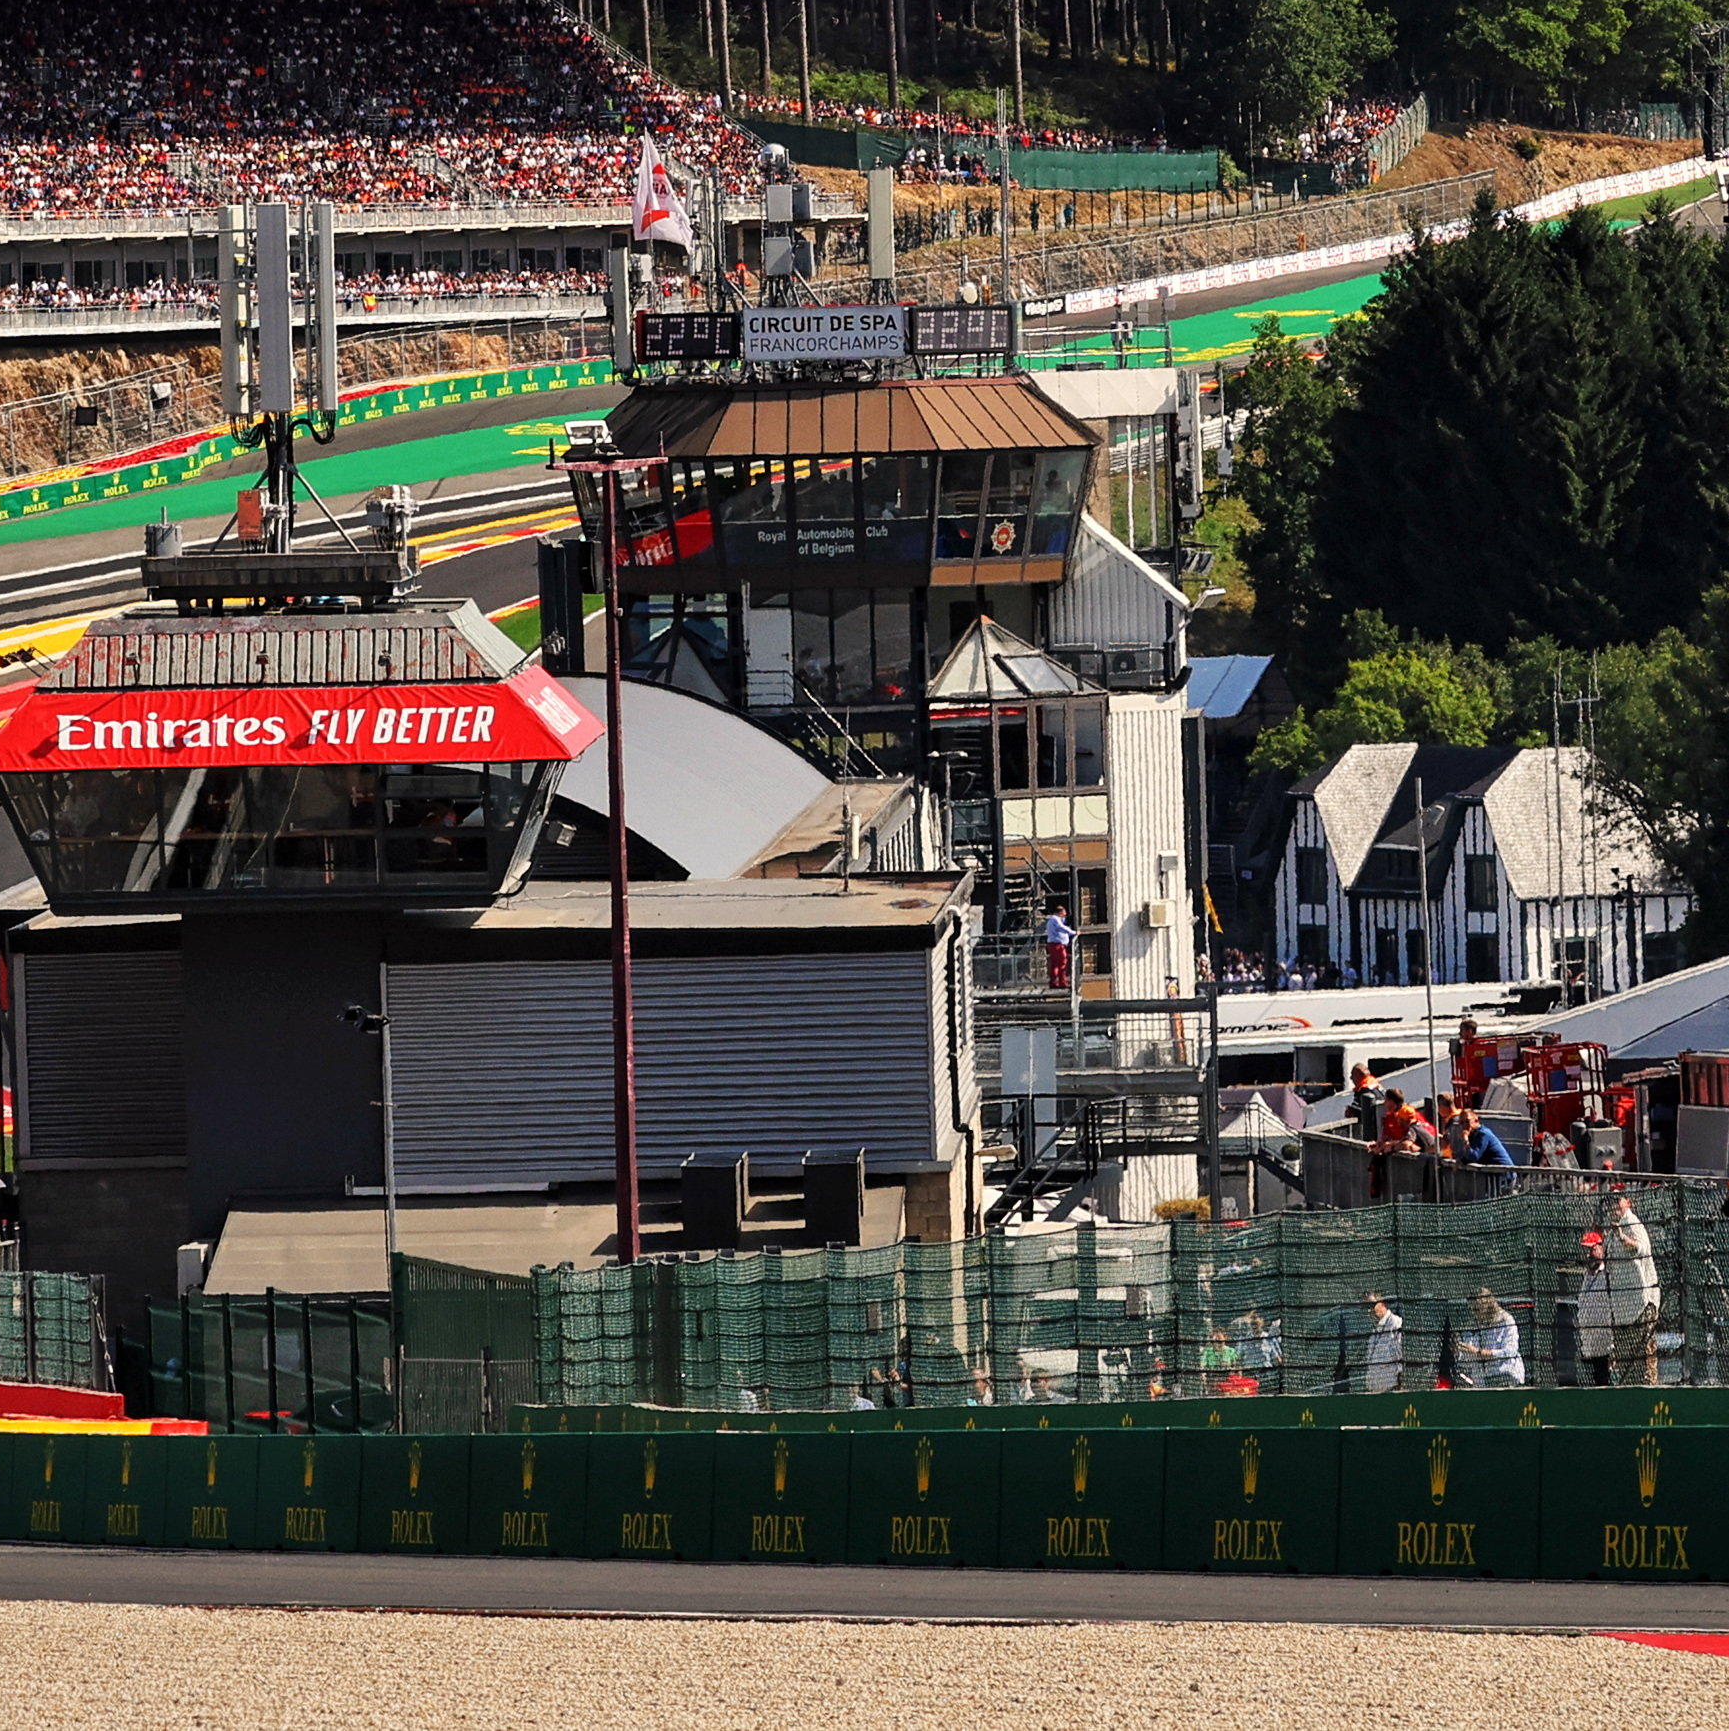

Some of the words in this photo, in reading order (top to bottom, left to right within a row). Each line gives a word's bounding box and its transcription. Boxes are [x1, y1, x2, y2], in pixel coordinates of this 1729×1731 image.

[749, 316, 823, 334] CIRCUIT
[830, 315, 854, 332] DE
[859, 314, 897, 331] SPA
[749, 336, 899, 353] FRANCORCHAMPS
[23, 501, 49, 514] ROLEX
[63, 492, 90, 505] ROLEX
[104, 484, 129, 497] ROLEX
[758, 530, 786, 543] Royal
[796, 528, 855, 541] Automobile
[865, 526, 889, 537] Club
[798, 544, 810, 555] of
[812, 543, 855, 558] Belgium
[56, 711, 287, 752] Emirates
[307, 708, 363, 746] FLY
[372, 705, 495, 745] BETTER
[192, 1506, 228, 1539] ROLEX
[285, 1507, 327, 1541] ROLEX
[391, 1510, 434, 1545] ROLEX
[502, 1512, 549, 1546] ROLEX
[622, 1513, 672, 1551] ROLEX
[752, 1515, 805, 1553] ROLEX
[892, 1516, 951, 1555] ROLEX
[1047, 1517, 1111, 1557] ROLEX
[1214, 1520, 1282, 1561] ROLEX
[1398, 1522, 1476, 1566] ROLEX
[1604, 1524, 1689, 1571] ROLEX
